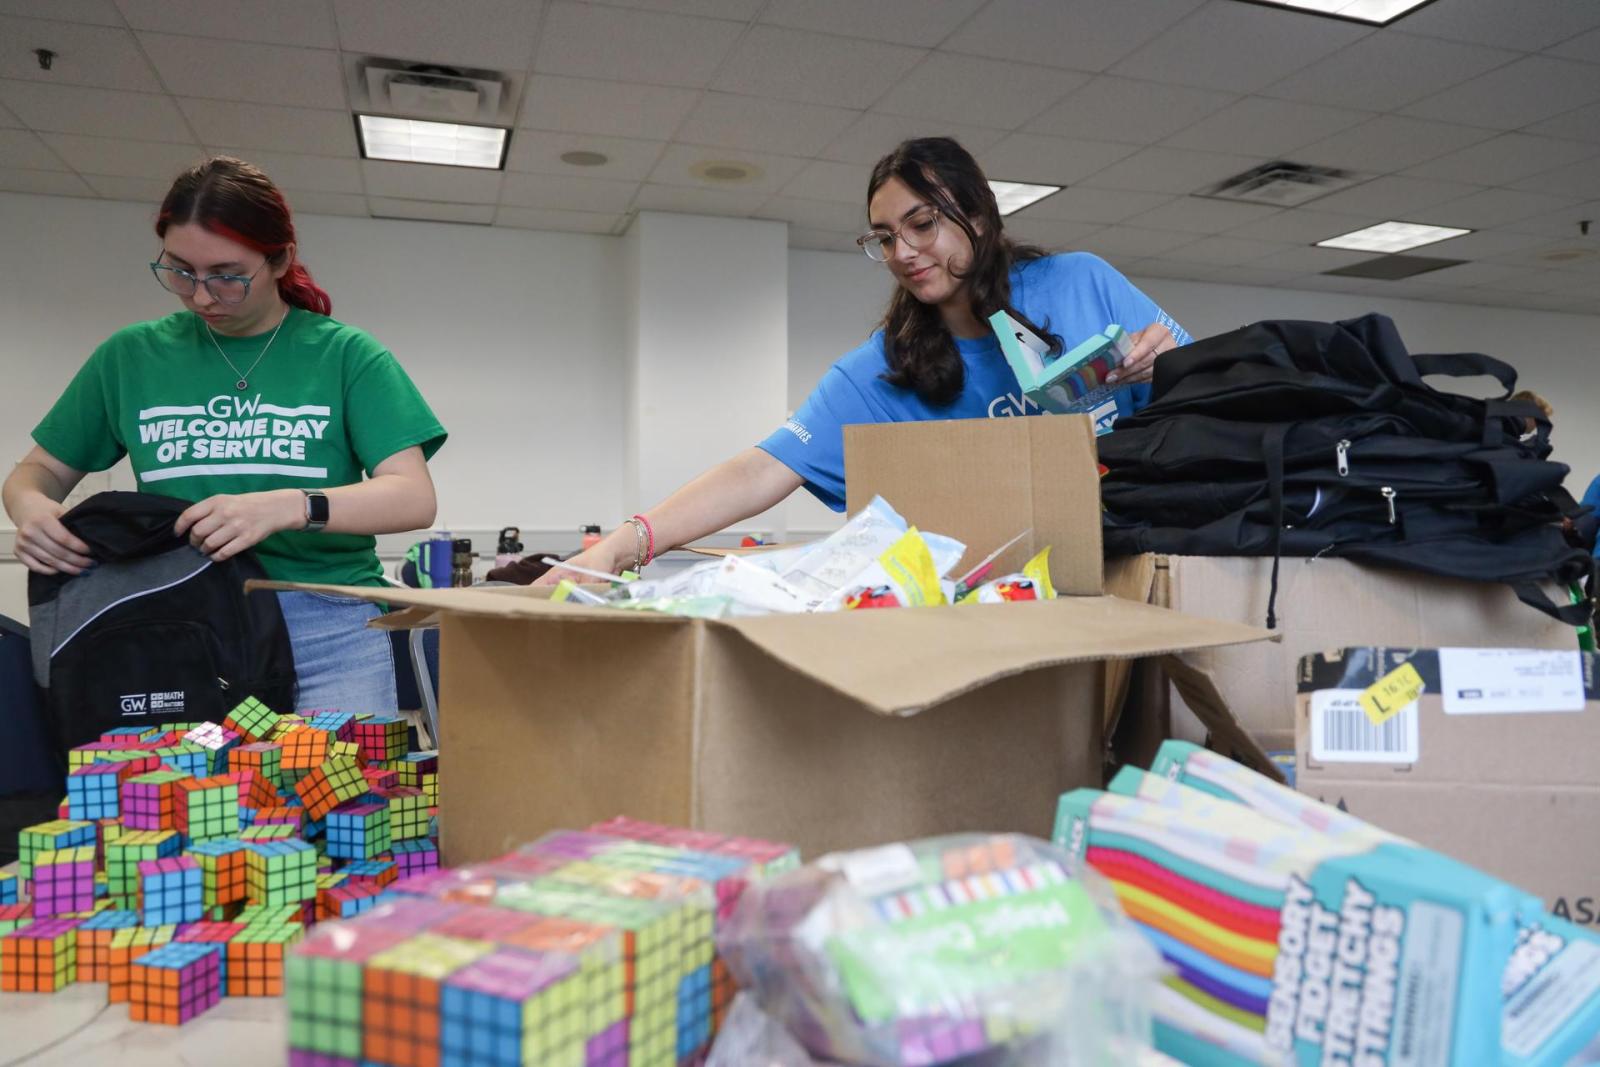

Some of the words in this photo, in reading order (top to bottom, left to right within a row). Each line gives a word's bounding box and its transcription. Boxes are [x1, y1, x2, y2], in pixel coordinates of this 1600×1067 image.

[207, 393, 261, 418] GW
[139, 418, 269, 444] WELCOME
[271, 419, 329, 439] DAY
[156, 439, 189, 463] OF
[191, 438, 306, 461] SERVICE
[121, 698, 146, 712] GW
[163, 691, 184, 700] MATH
[1552, 897, 1600, 925] AS
[1265, 872, 1315, 1052] SENSORY
[1295, 900, 1340, 1043] FIDGET
[1321, 875, 1376, 1067] TRETCHY
